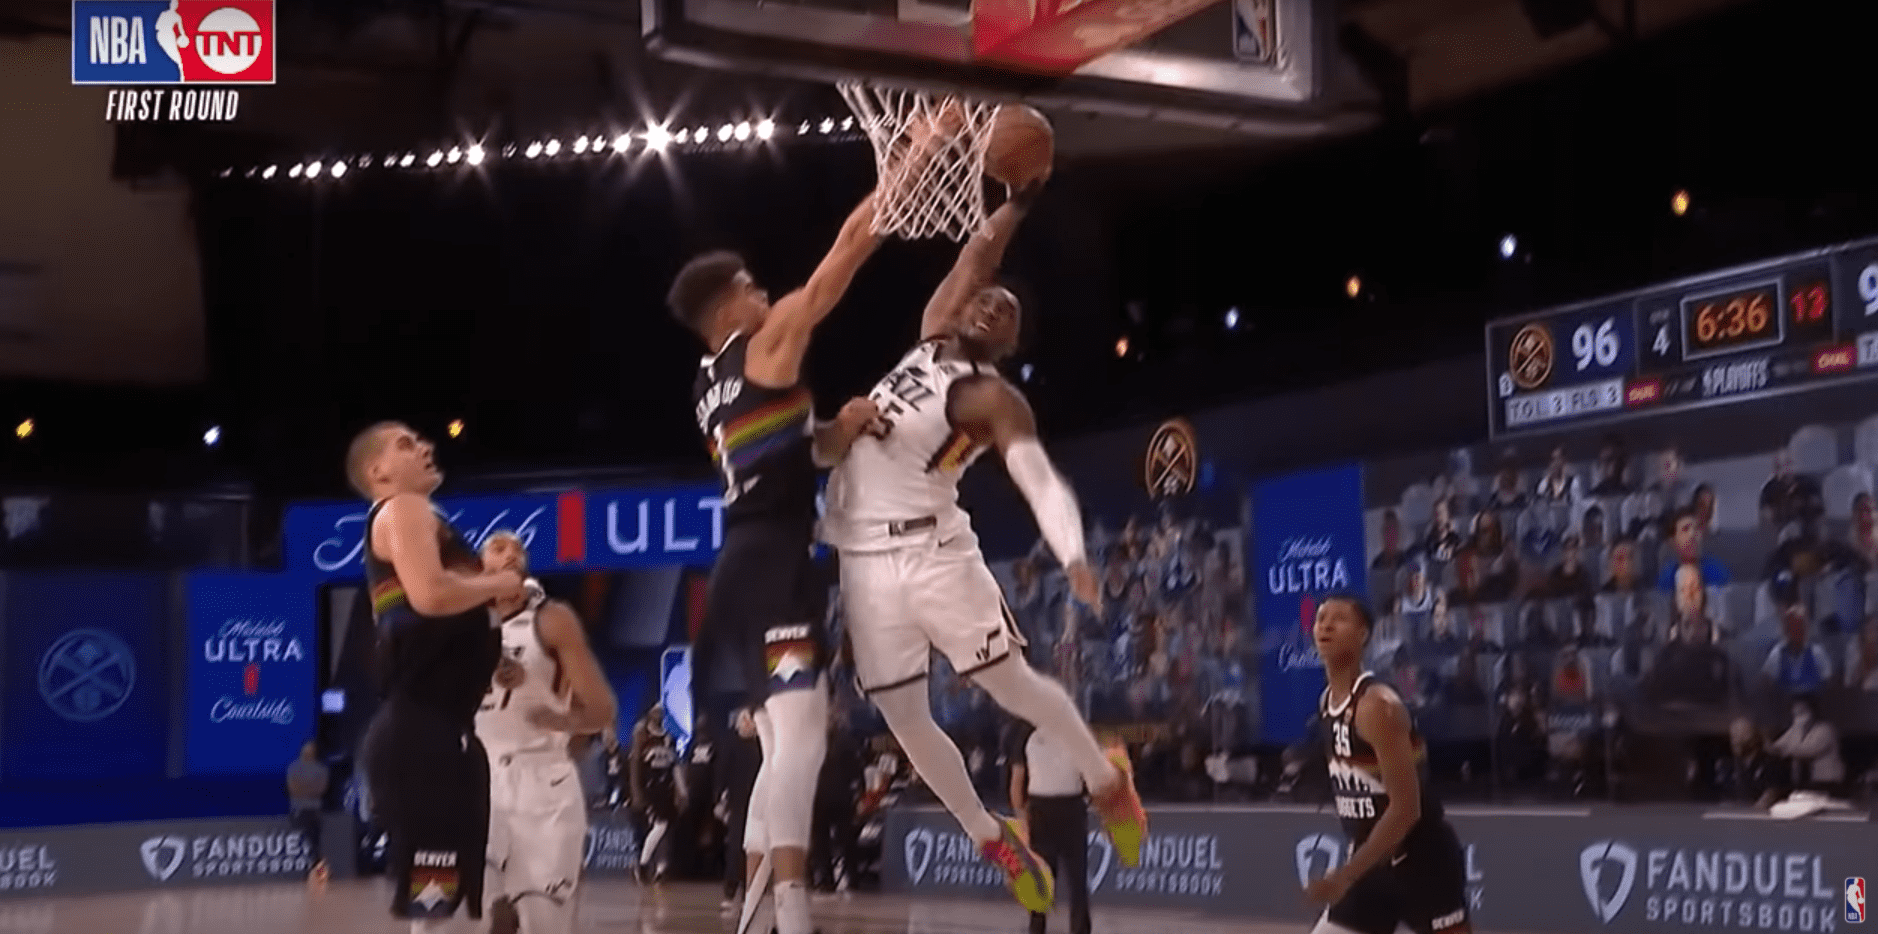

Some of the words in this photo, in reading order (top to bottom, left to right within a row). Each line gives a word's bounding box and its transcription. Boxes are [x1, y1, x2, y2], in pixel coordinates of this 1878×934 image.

[1696, 293, 1769, 342] 6:36
[1571, 316, 1619, 372] 96
[1653, 323, 1671, 357] 4
[1268, 557, 1348, 594] ULTRA
[204, 637, 304, 663] ULTRA
[1333, 720, 1352, 758] 35
[1140, 834, 1222, 869] NDUEL
[1116, 870, 1223, 895] SPORTSBOOK
[1647, 849, 1835, 900] FANDUEL
[1646, 895, 1838, 933] SPORTSBOOK
